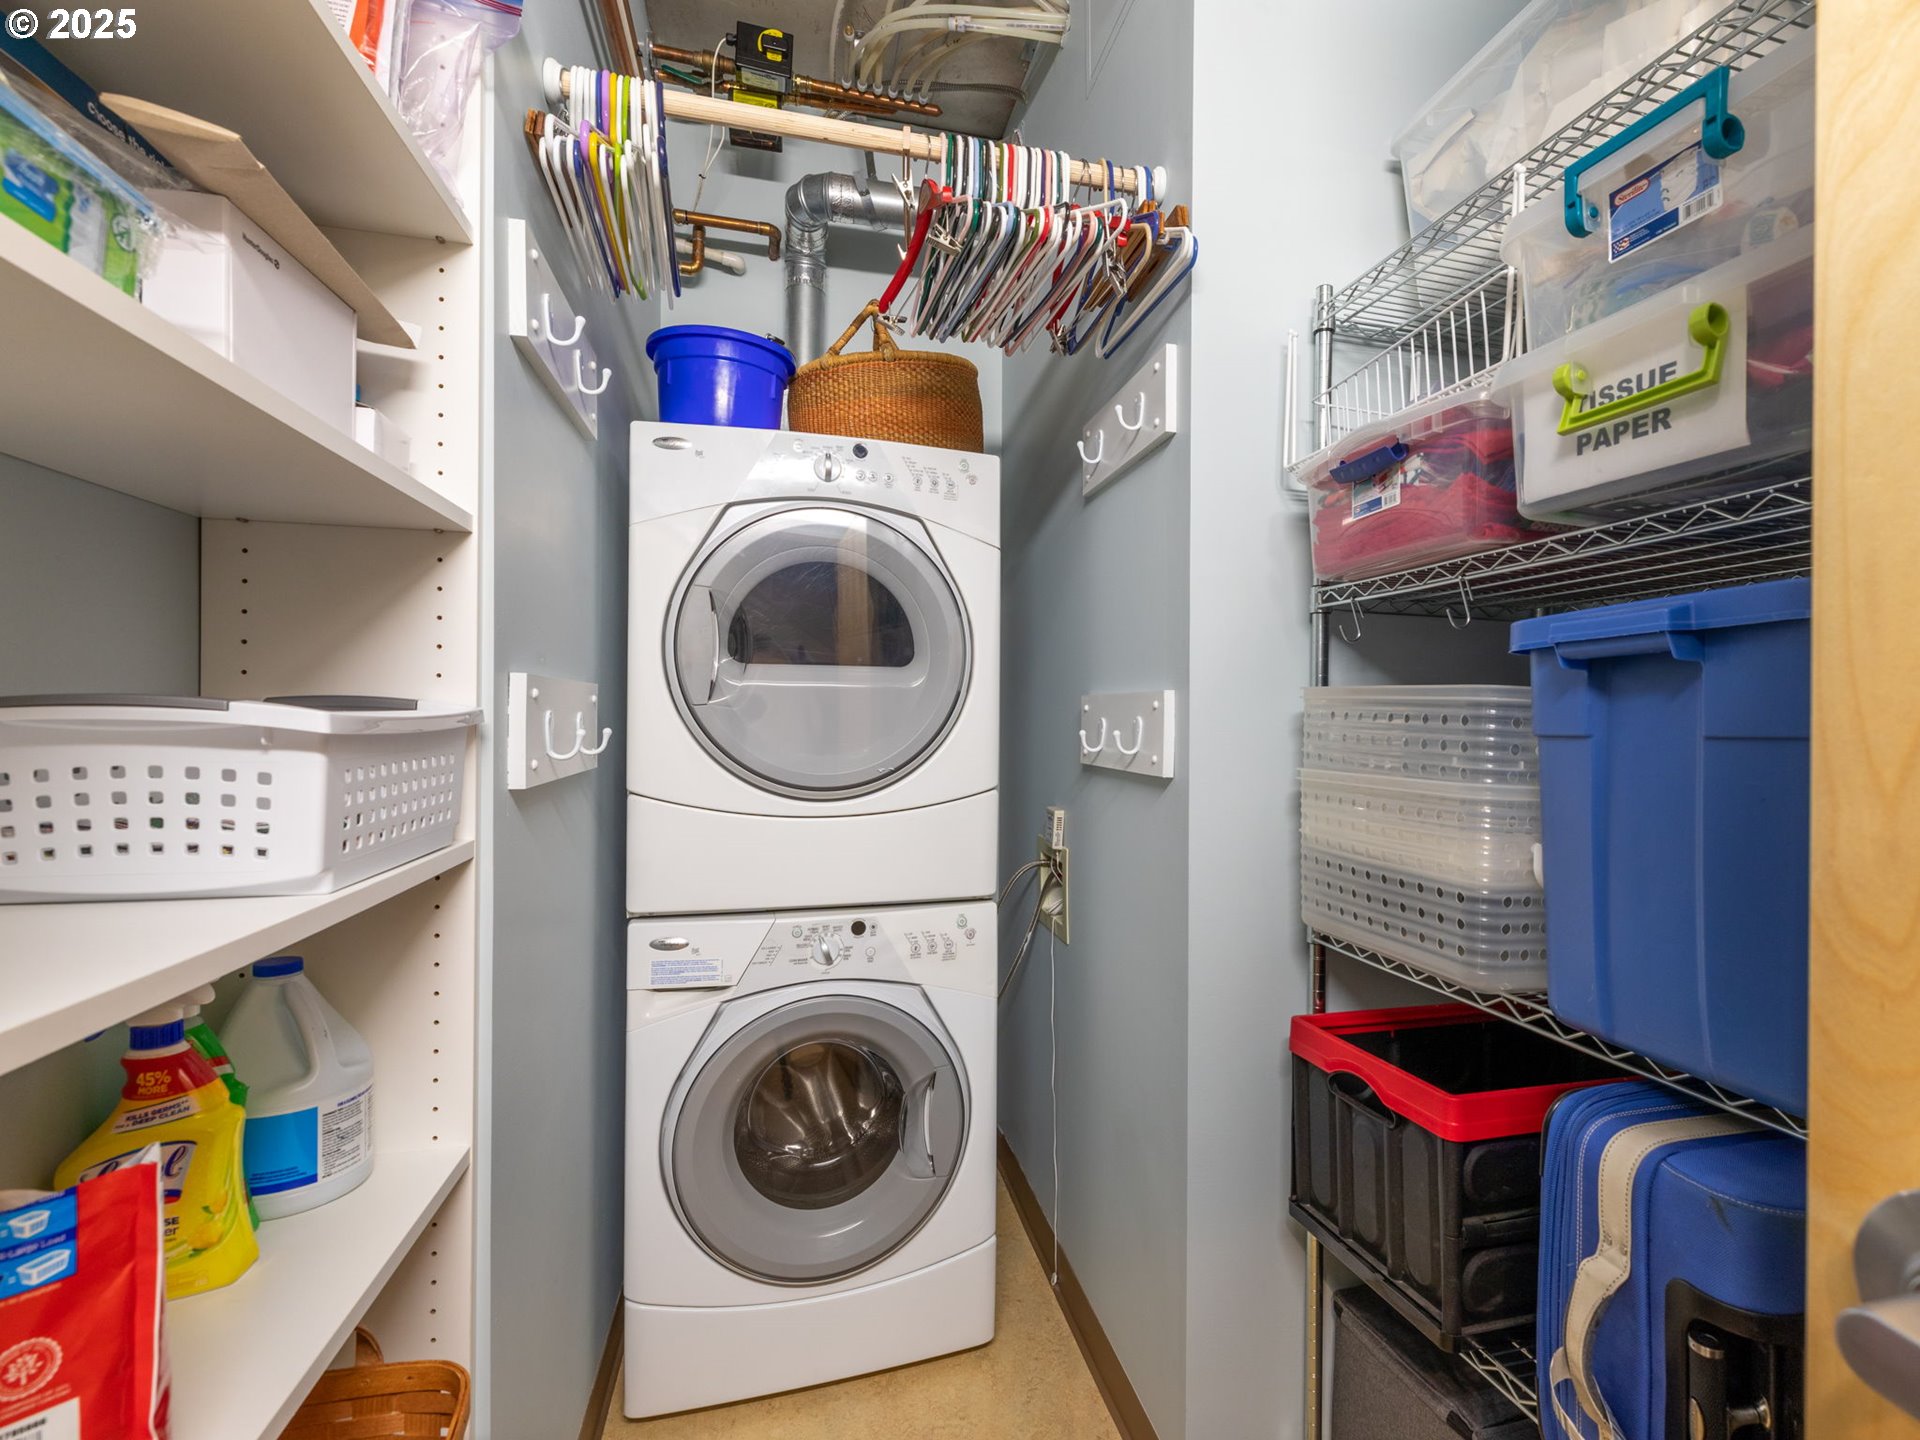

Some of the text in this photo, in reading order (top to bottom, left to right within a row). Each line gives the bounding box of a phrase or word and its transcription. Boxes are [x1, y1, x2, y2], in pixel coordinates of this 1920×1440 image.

[1576, 407, 1672, 456] PAPER
[136, 1069, 171, 1087] 45%
[137, 1084, 168, 1095] MORE
[159, 1106, 190, 1119] CLEAN
